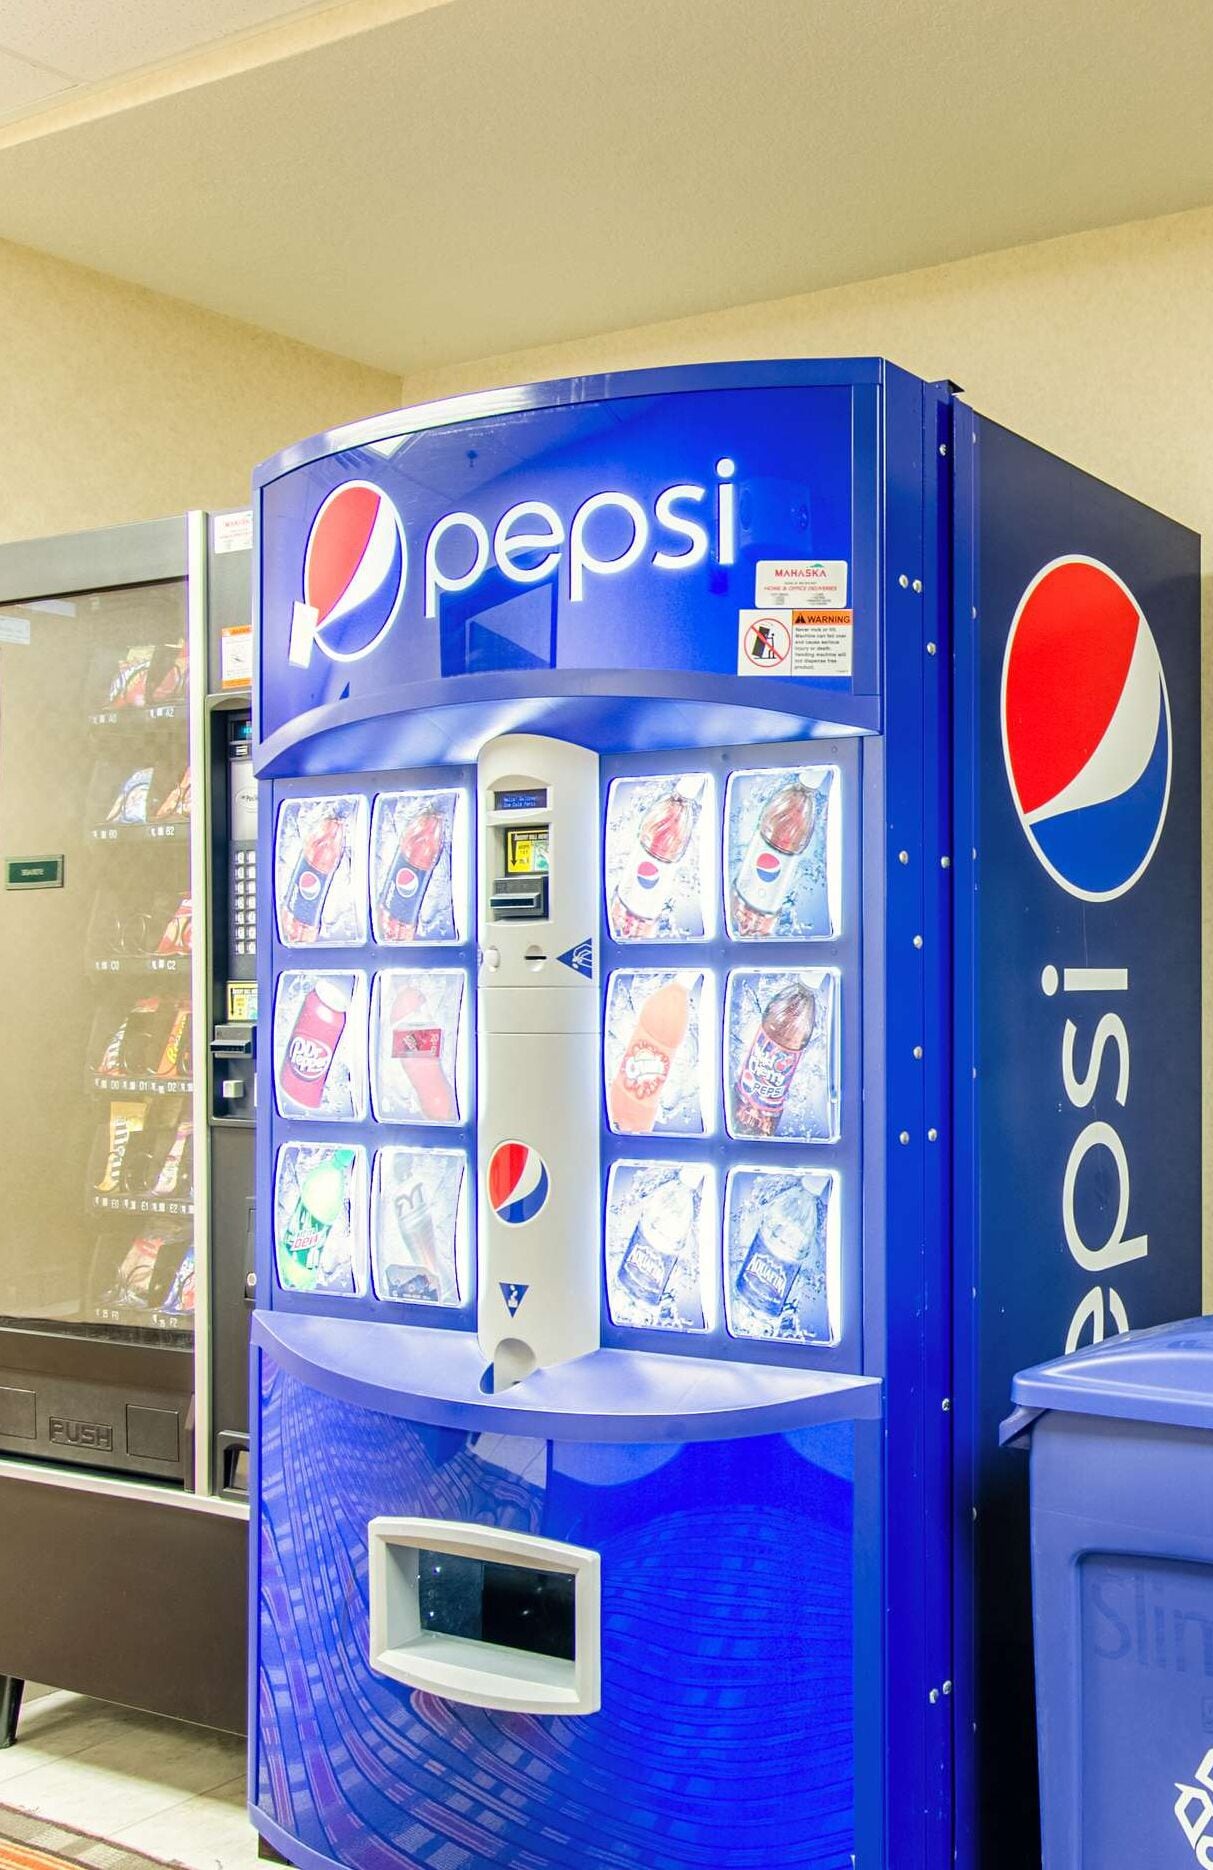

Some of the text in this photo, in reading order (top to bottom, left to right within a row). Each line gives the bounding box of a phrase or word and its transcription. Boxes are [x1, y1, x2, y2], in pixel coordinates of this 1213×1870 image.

[424, 457, 736, 618] pepsi
[774, 569, 827, 578] MAHASKA
[807, 615, 850, 624] WARNING
[52, 1421, 111, 1447] PUSH
